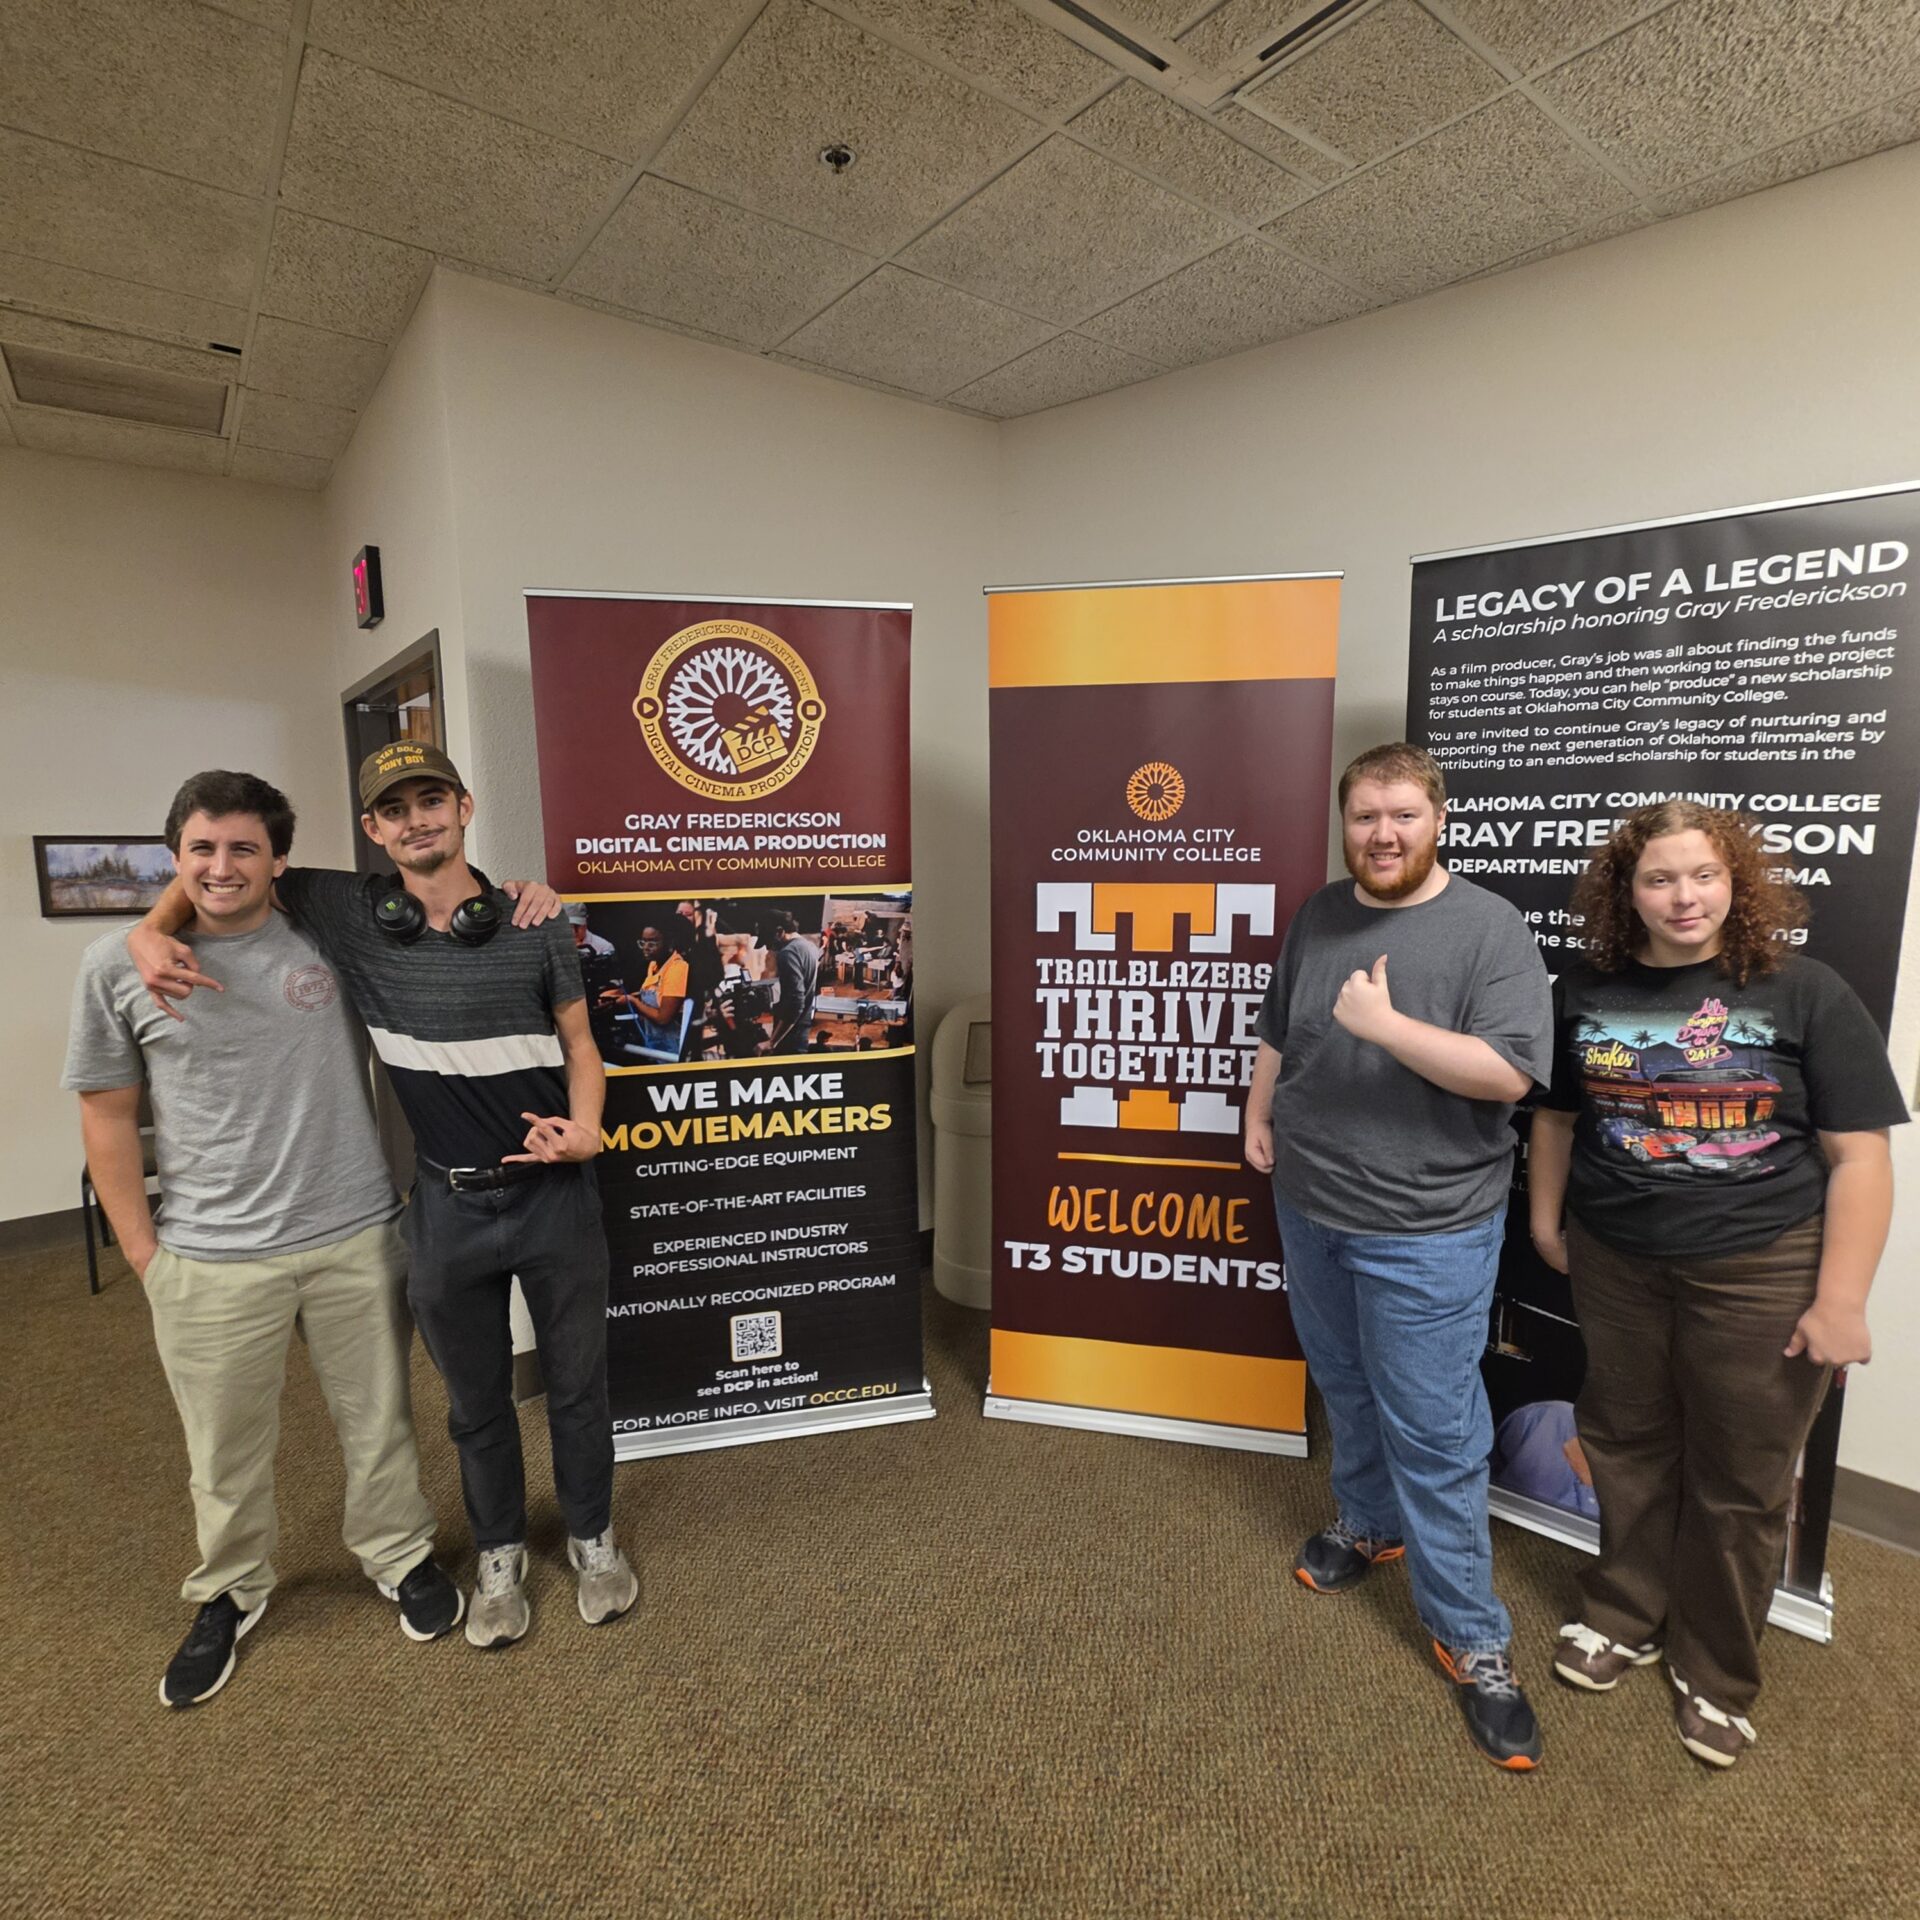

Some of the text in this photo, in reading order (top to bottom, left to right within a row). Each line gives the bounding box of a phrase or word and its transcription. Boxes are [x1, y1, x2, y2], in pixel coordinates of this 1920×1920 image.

[1436, 540, 1909, 622] LEGACY OF A LEGEND
[1432, 581, 1907, 643] A scholarship honoring Gray Frederickson
[645, 624, 811, 695] GRAY FREDERICKSON DEPARTMENT
[1430, 627, 1897, 676] As a film producer, Gray's job was all about finding the funds
[1430, 646, 1895, 691] to make things happen and then working to ensure the project
[1429, 695, 1459, 706] stays
[1461, 694, 1478, 703] on
[1480, 691, 1526, 702] course.
[1528, 686, 1571, 699] Today,
[1573, 686, 1599, 698] you
[1601, 683, 1627, 694] can
[1630, 679, 1661, 693] help
[1737, 675, 1747, 685] a
[1750, 672, 1787, 684] new
[1789, 663, 1893, 682] scholarship
[1429, 689, 1788, 719] for students at Oklahoma City Community College.
[1427, 709, 1887, 741] You are invited to continue Gray's legacy of nurturing and
[737, 735, 776, 761] DCP
[1427, 728, 1885, 758] supporting the next generation of Oklahoma filmmakers by
[1436, 746, 1856, 770] ntributing to an endowed scholarship for students in the
[379, 755, 425, 774] PONY BOY
[644, 723, 816, 797] DIGITAL CINEMA PRODUCTION
[1443, 795, 1545, 813] KLAHOMA
[1550, 793, 1602, 810] CITY
[1749, 793, 1881, 813] COLLEGE
[625, 812, 840, 830] GRAY FREDERICKSON
[1077, 828, 1235, 843] OKLAHOMA CITY
[576, 833, 886, 854] DIGITAL CINEMA PRODUCTION
[1051, 847, 1261, 861] COMMUNITY COLLEGE
[577, 854, 886, 874] OKLAHOMA CITY COMMUNITY COLLEGE
[1448, 858, 1592, 875] DEPARTMENT
[1534, 930, 1561, 947] he
[1036, 958, 1273, 990] TRAILBLAZERS
[1036, 988, 1266, 1046] THRIVE
[1586, 1041, 1633, 1071] Shakes
[647, 1072, 843, 1112] WE MAKE
[599, 1103, 892, 1152] MOVIEMAKERS
[636, 1146, 858, 1177] CUTTING-EDGE EQUIPMENT
[630, 1184, 866, 1219] STATE-OF-THE-ART FACILITIES
[1048, 1185, 1250, 1244] WELCOME
[653, 1222, 848, 1254] EXPERIENCED INDUSTRY
[633, 1241, 868, 1277] PROFESSIONAL INSTRUCTORS
[1004, 1241, 1051, 1271] T3
[605, 1274, 895, 1318] NATIONALLY RECOGNIZED PROGRAM
[697, 1371, 818, 1397] see DCP in action!
[715, 1361, 799, 1380] Scan here to
[612, 1417, 650, 1432] FOR
[655, 1408, 709, 1426] MORE
[763, 1394, 806, 1410] VISIT
[809, 1382, 896, 1404] OCCC.EDU
